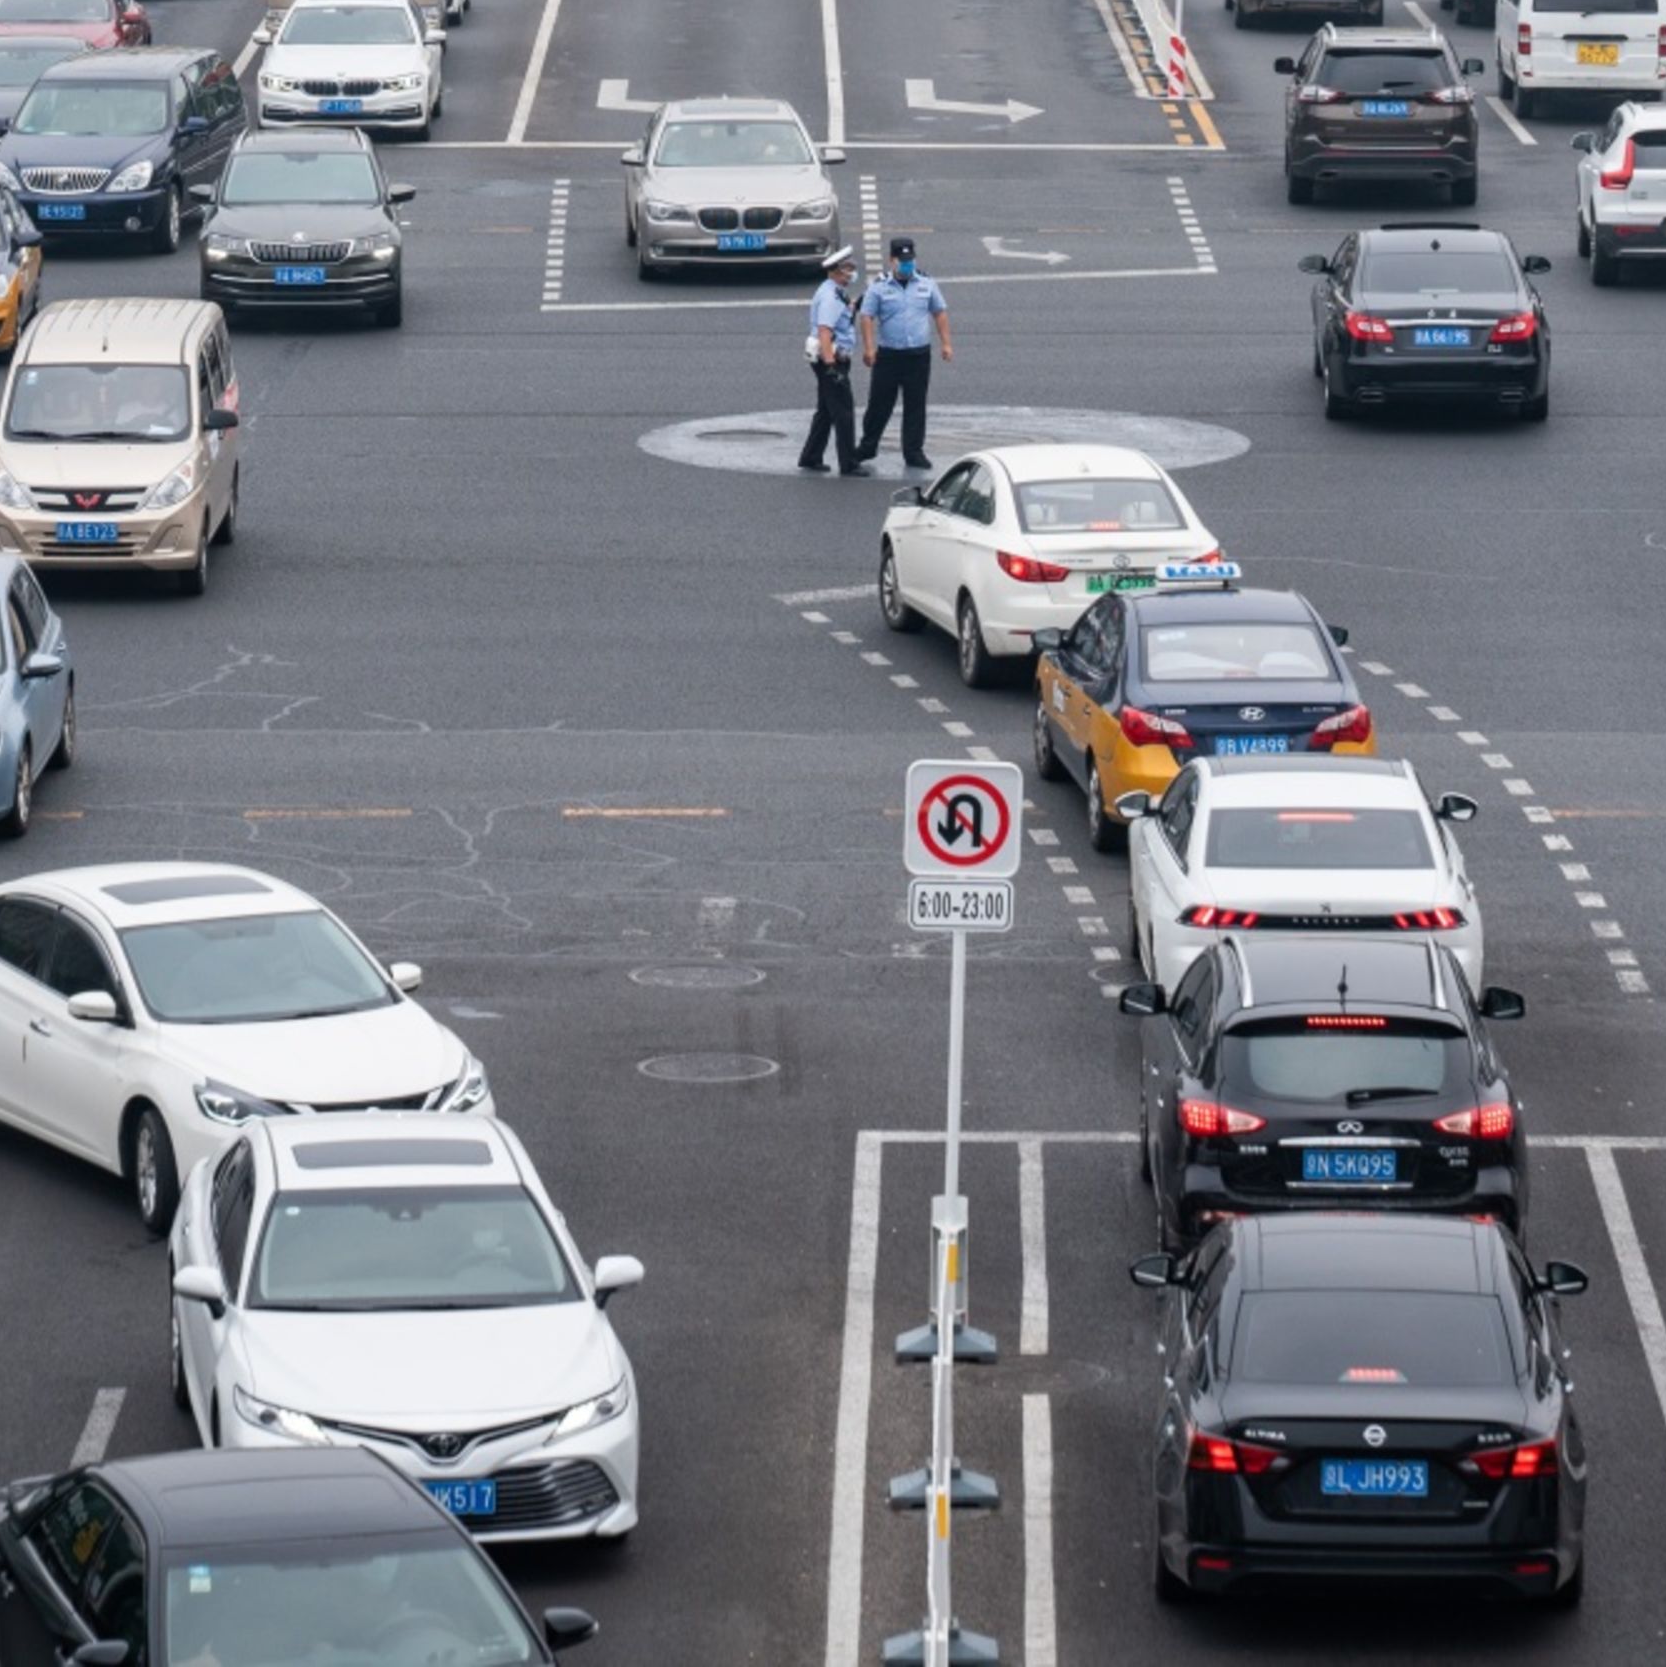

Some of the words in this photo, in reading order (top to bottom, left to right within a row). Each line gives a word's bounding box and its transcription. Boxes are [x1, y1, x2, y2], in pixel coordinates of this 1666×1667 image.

[917, 890, 1004, 920] 6:00-23:00
[1334, 1152, 1395, 1177] 5KQ95
[1358, 1465, 1426, 1491] JH993
